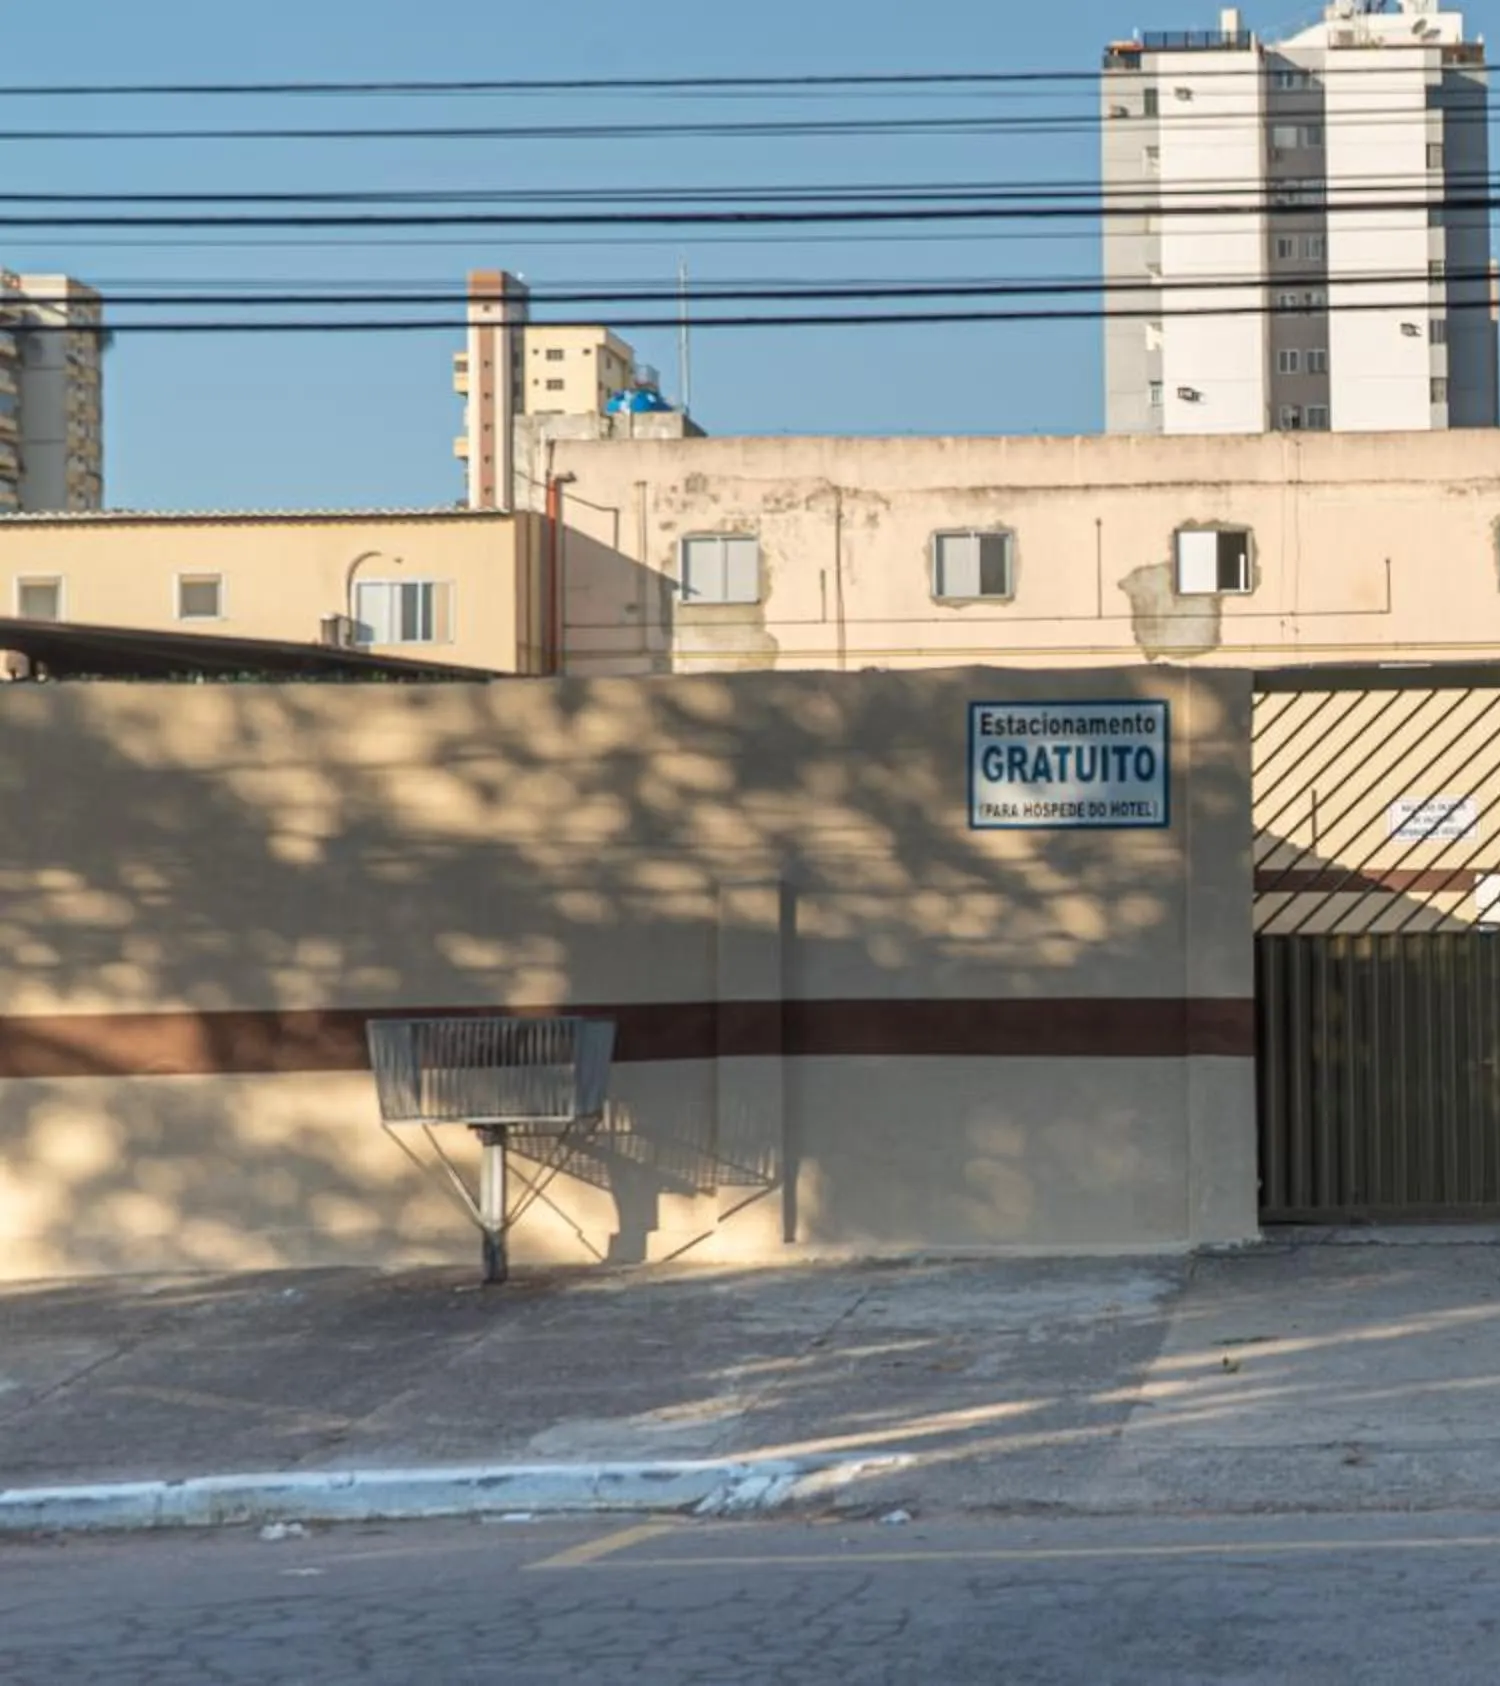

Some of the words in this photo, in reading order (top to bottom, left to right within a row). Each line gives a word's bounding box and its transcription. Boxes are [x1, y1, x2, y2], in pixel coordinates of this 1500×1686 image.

[979, 711, 1156, 736] Estacionamento
[981, 744, 1156, 784] GRATUITO
[979, 802, 1019, 819] (PARA
[1088, 801, 1106, 818] DO
[1110, 800, 1159, 818] HOTEL)
